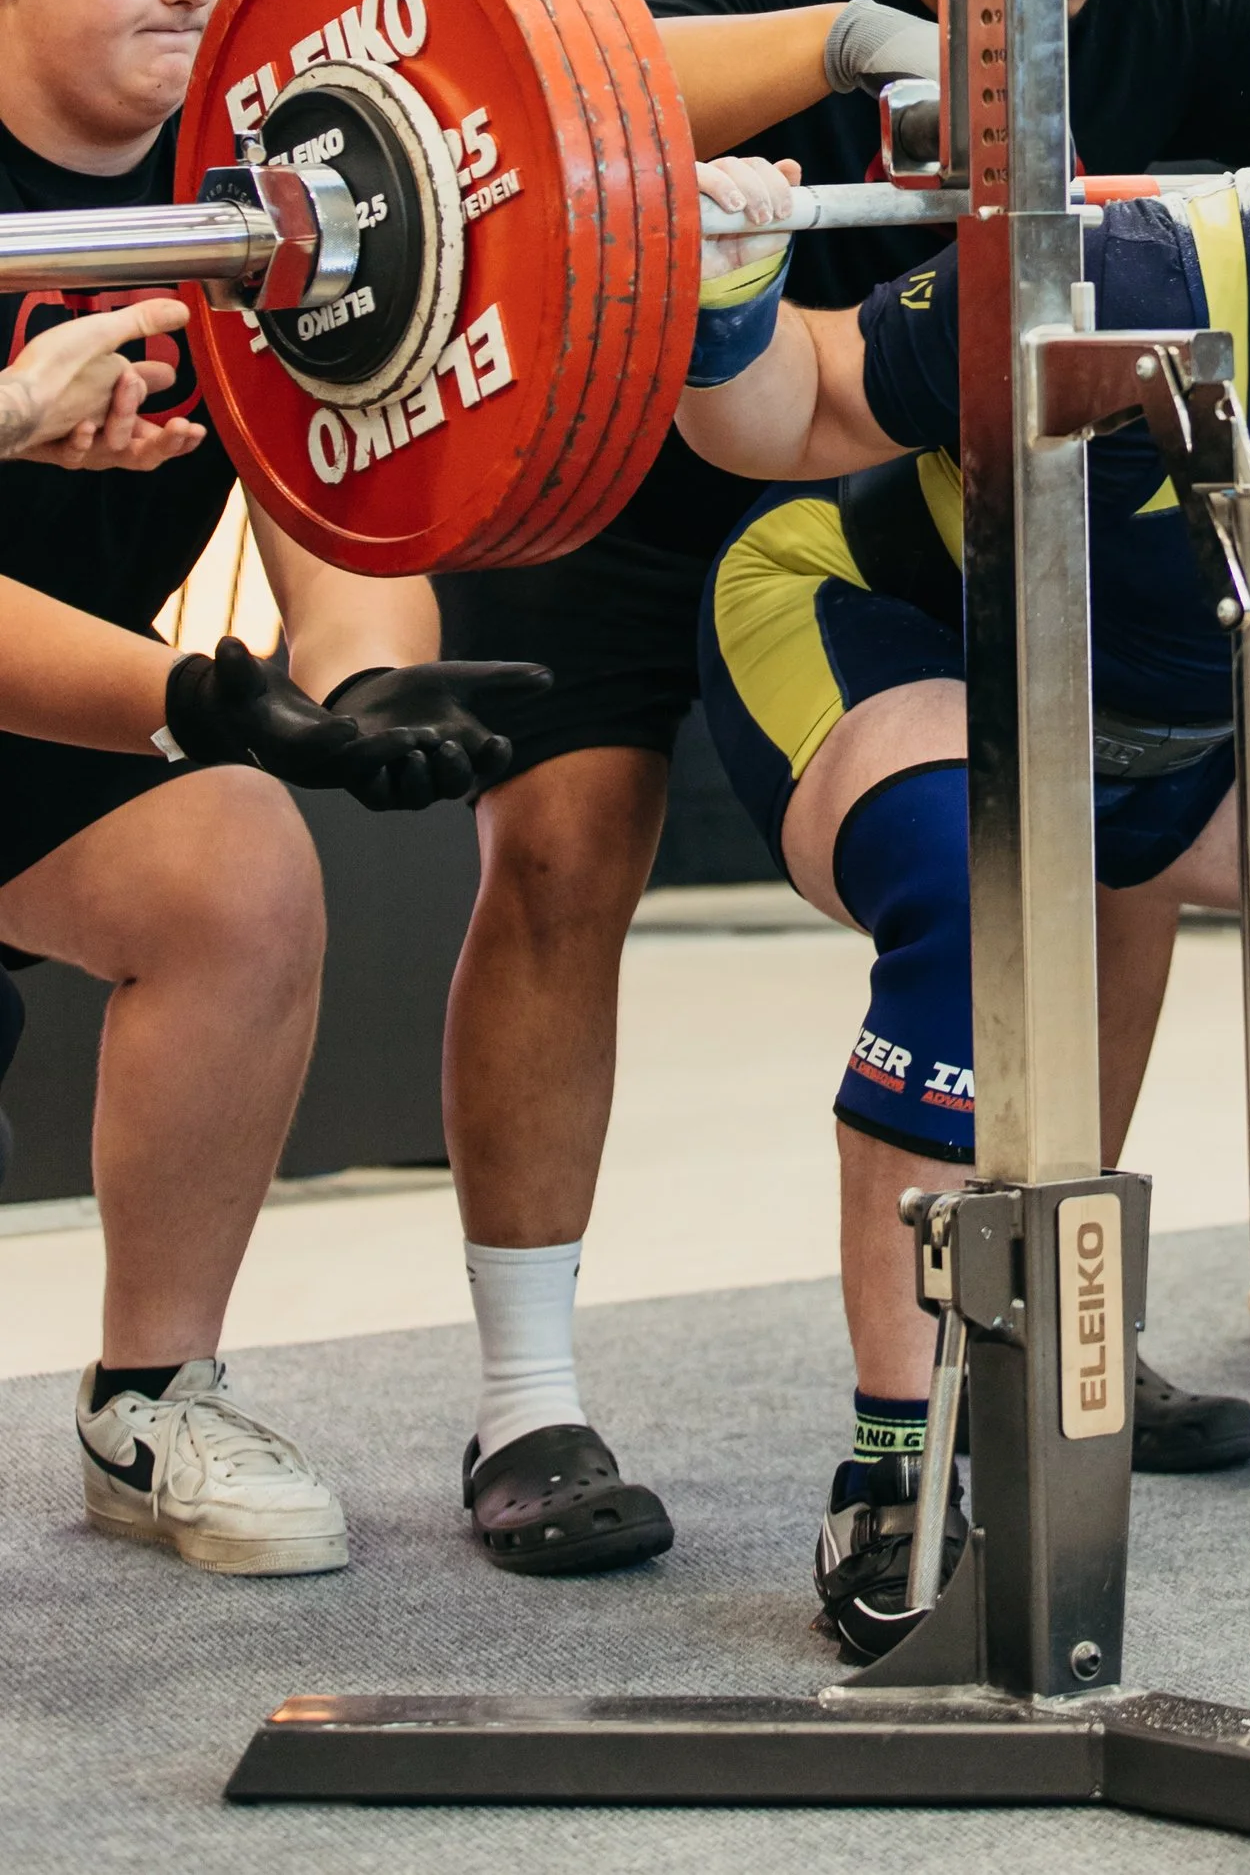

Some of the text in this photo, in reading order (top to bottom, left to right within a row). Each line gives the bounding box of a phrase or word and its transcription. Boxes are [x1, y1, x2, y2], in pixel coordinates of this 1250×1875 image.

[461, 168, 521, 224] EDEN
[297, 285, 376, 342] ELEIKO
[854, 1026, 913, 1079] ZER
[1076, 1221, 1107, 1412] ELEIKO
[856, 1425, 896, 1448] AND
